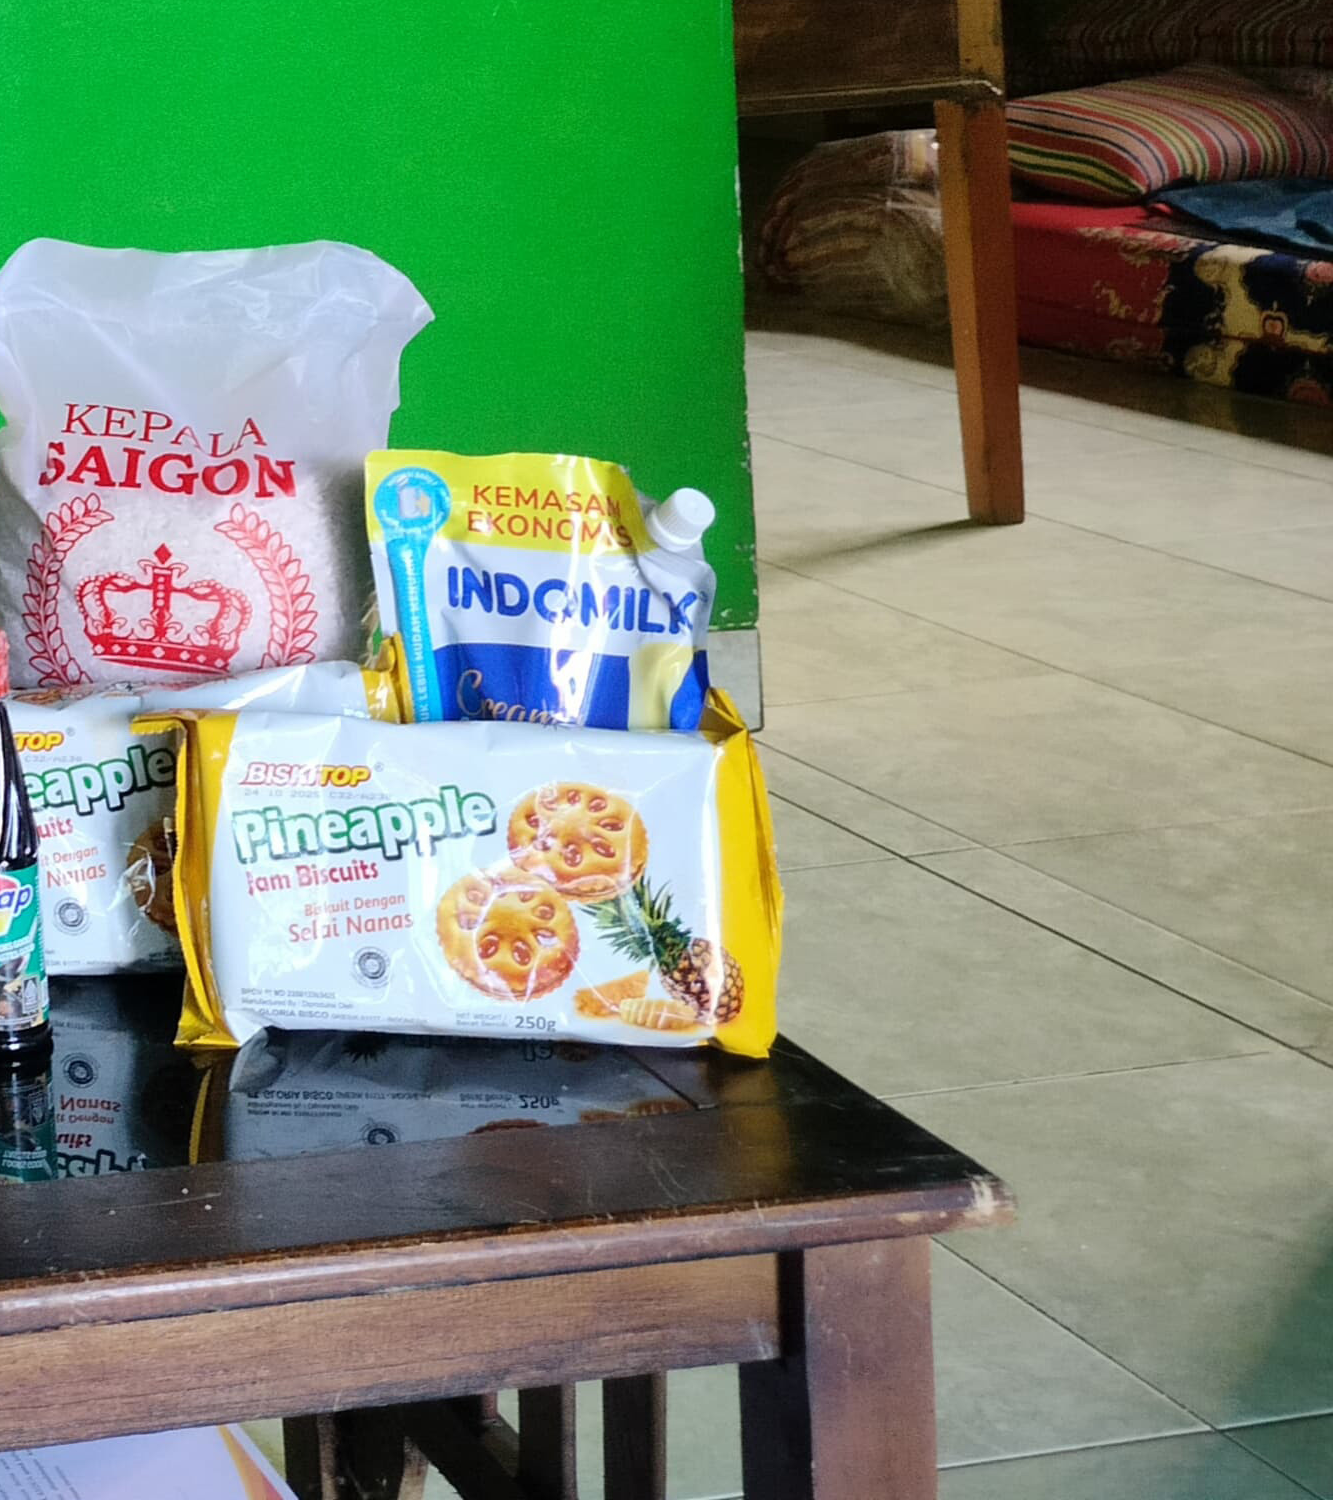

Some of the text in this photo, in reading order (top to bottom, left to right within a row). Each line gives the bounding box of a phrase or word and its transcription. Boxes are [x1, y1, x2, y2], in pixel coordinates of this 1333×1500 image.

[62, 403, 267, 458] KEPALA
[39, 441, 296, 499] SAIGON
[473, 485, 622, 519] KEMASAN
[467, 510, 634, 549] EKONOMIS
[448, 565, 700, 636] INDOMILK
[232, 785, 497, 865] Pineapple
[295, 858, 380, 889] Biscuits
[354, 894, 406, 914] Dengan
[346, 911, 415, 937] Nanas
[514, 1014, 557, 1033] 250g
